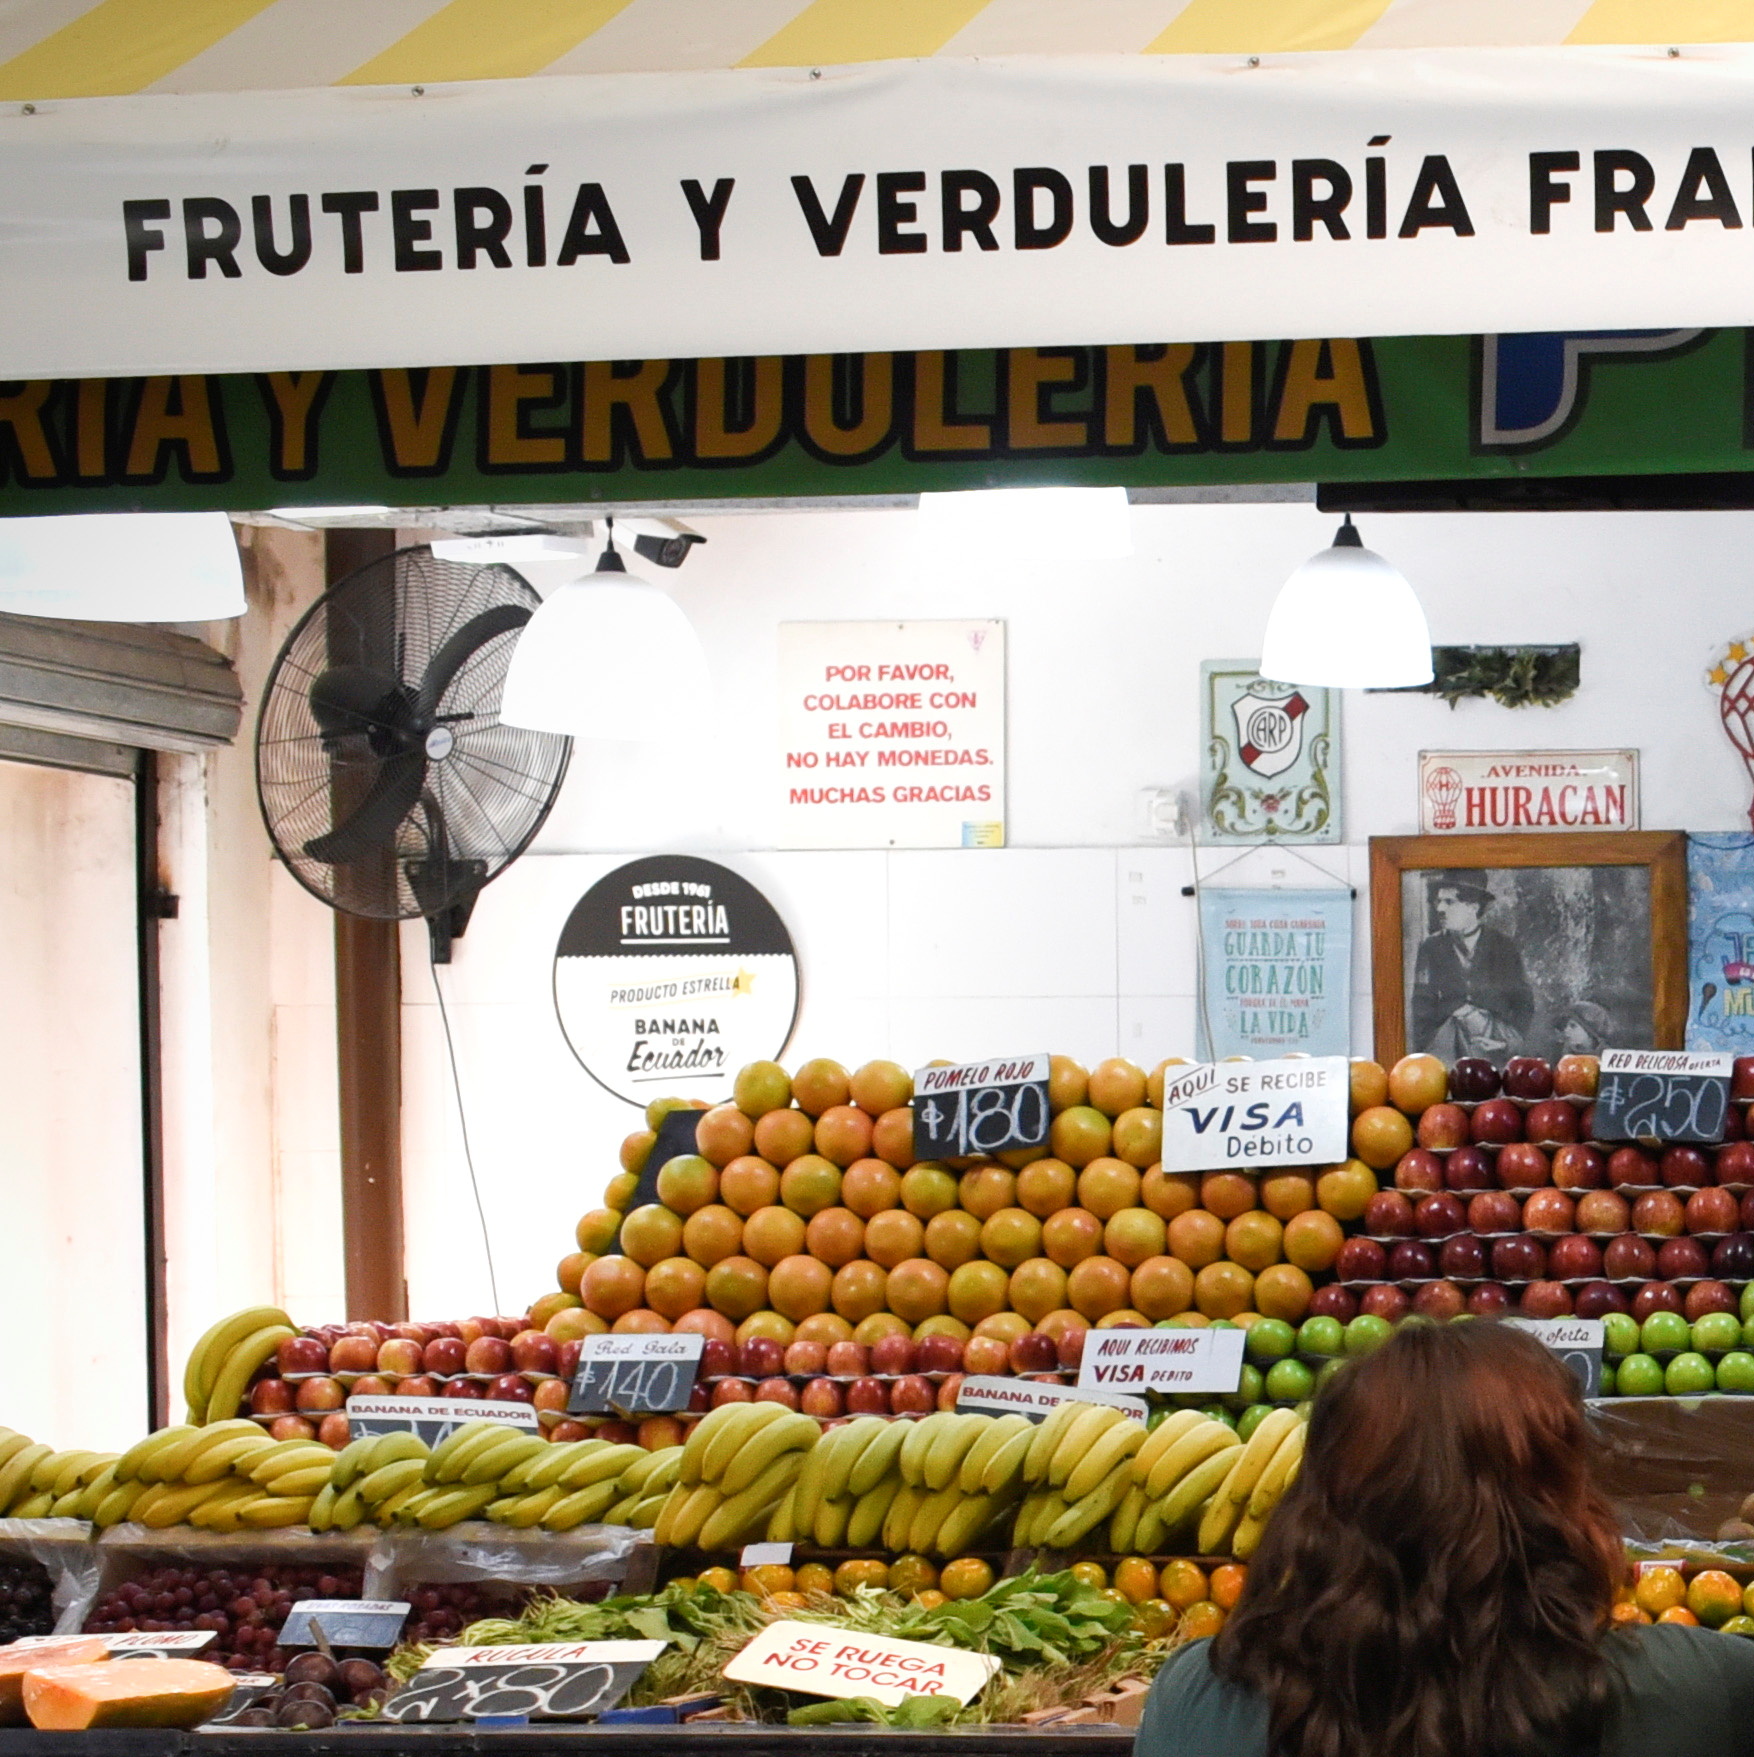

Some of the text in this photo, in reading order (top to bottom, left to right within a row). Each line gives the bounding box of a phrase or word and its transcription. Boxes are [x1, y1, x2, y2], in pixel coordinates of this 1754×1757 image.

[122, 164, 631, 282] FRUTERÍA
[679, 177, 736, 261] Y
[790, 135, 1476, 257] VERDULERÍA
[825, 664, 871, 682] POR
[803, 692, 977, 711] COLABORE CON
[828, 723, 852, 739] EL
[786, 751, 819, 768] NO
[825, 751, 870, 767] HAY
[789, 784, 992, 804] MUCHAS GRACIAS
[1464, 783, 1627, 828] HURACAN
[631, 881, 712, 900] DESDE 1961
[620, 900, 731, 936] FRUTERÍA
[1224, 931, 1297, 957] GUARDA
[609, 975, 741, 1004] PRODUCTO ESTRELLA
[634, 1018, 721, 1036] BANANA
[1240, 1010, 1309, 1035] LA VIDA
[671, 1037, 686, 1047] DE
[626, 1037, 731, 1073] Ecuador
[1607, 1053, 1630, 1070] RED
[1635, 1053, 1688, 1071] DELICIOSA
[923, 1060, 1035, 1091] POMELO ROJO
[1226, 1076, 1251, 1094] SE
[1260, 1070, 1328, 1092] RECIBE
[1181, 1101, 1305, 1134] VISA
[1134, 1337, 1201, 1356] RECIBIMOS
[1093, 1364, 1146, 1383] VISA
[962, 1386, 1061, 1407] BANANA DE
[350, 1404, 533, 1422] BANANA DE ECUADOR
[788, 1637, 948, 1679] SE RUEGA
[762, 1650, 945, 1698] NO TOCAR
